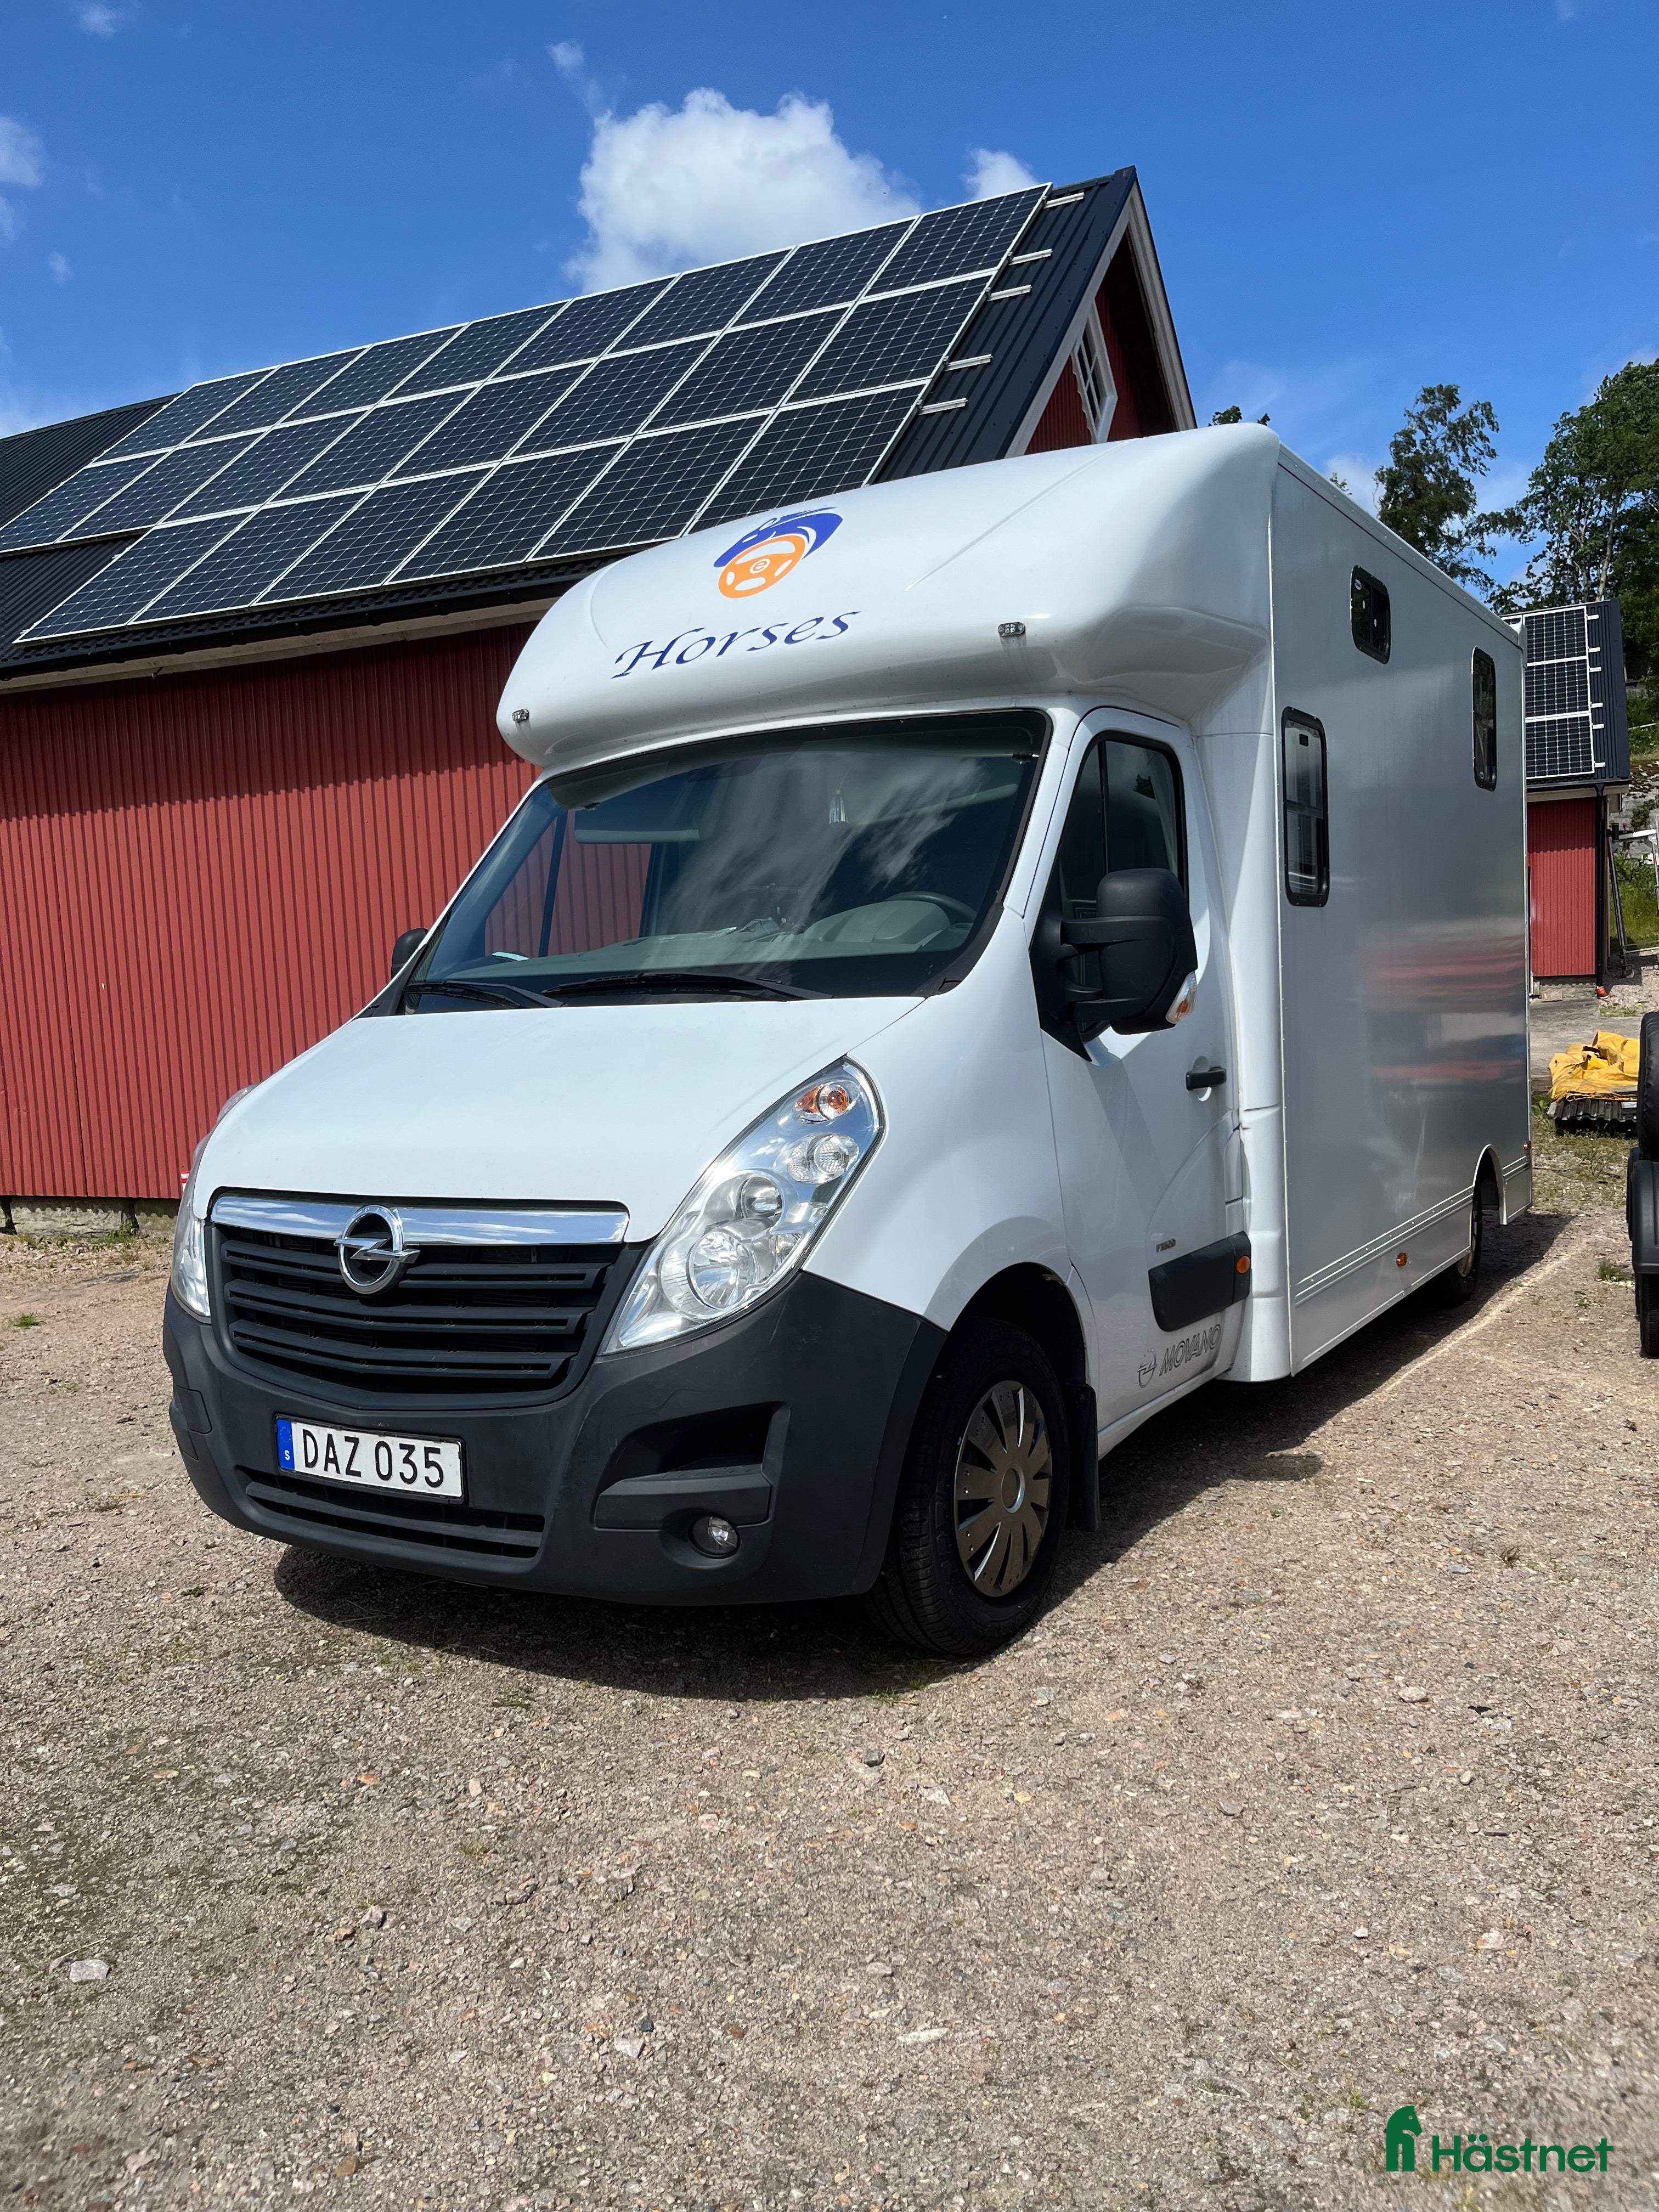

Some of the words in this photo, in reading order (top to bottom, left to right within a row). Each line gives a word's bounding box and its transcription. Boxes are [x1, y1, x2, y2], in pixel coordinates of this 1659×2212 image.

[610, 610, 862, 680] Horses
[1159, 1323, 1221, 1376] MOVANO
[284, 1449, 290, 1461] S
[302, 1429, 362, 1477] DAZ
[375, 1440, 444, 1488] 035
